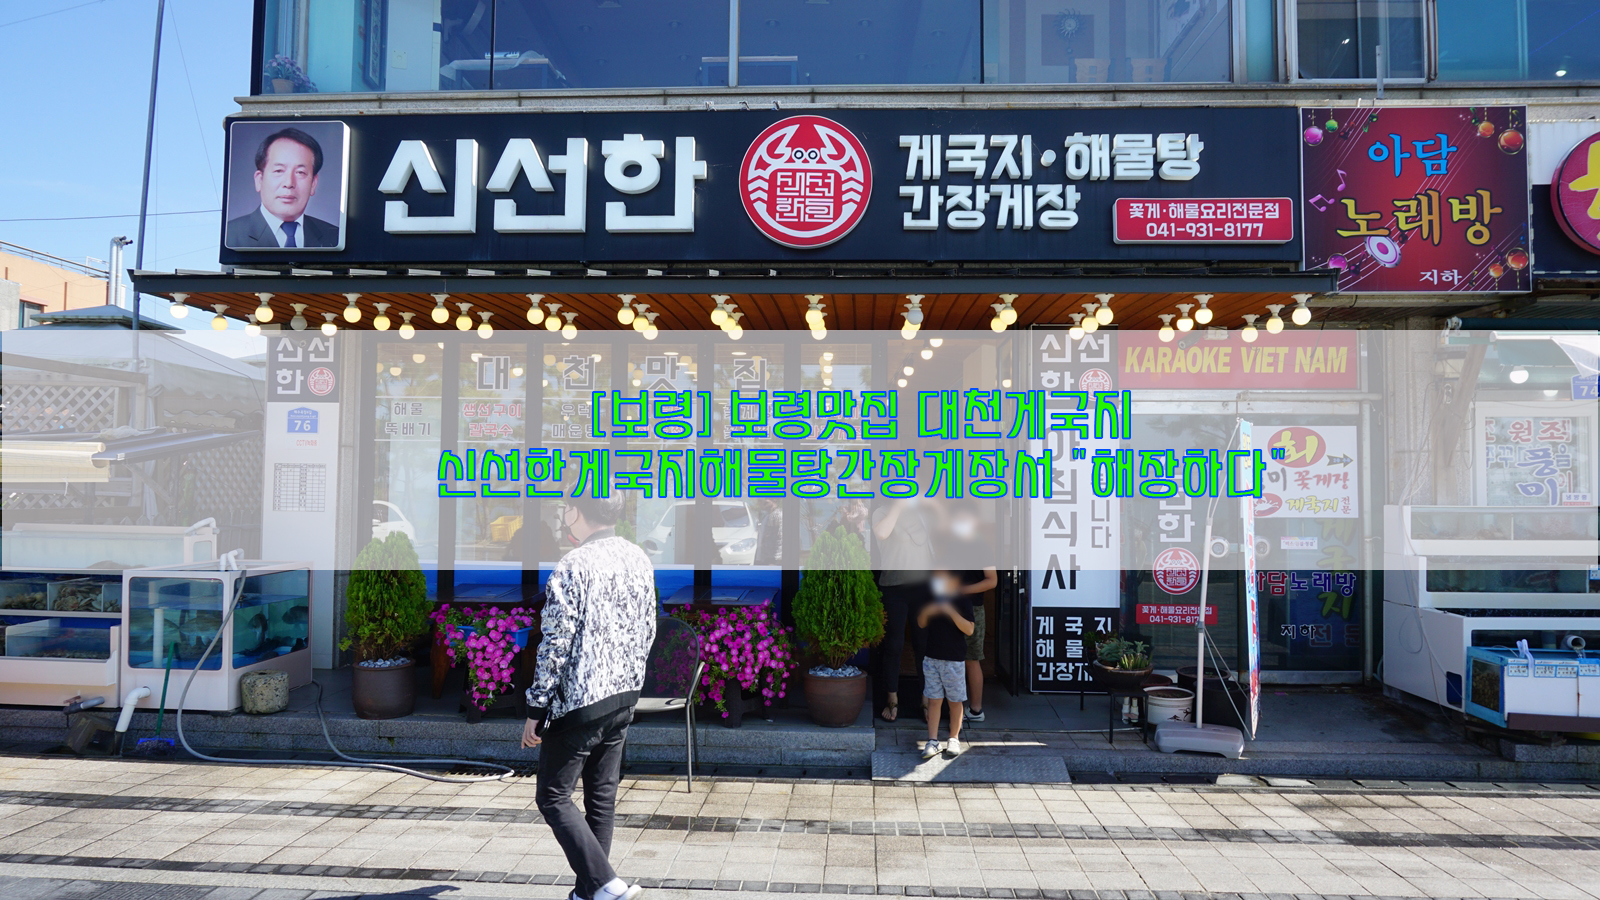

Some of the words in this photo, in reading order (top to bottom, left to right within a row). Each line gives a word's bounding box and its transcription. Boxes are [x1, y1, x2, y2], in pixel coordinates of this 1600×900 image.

[1368, 133, 1458, 177] 아담
[378, 133, 707, 234] 신선한
[900, 184, 1081, 230] 간장게장
[1336, 188, 1503, 246] 노래방
[1146, 223, 1264, 238] 041-931-8177
[1420, 269, 1462, 285] 지하
[276, 337, 335, 363] 신선
[1040, 333, 1110, 363] 신선
[1124, 346, 1232, 374] KARAOKE
[1240, 346, 1290, 374] VIET
[1294, 346, 1348, 374] NAM
[276, 368, 305, 395] 한
[1580, 385, 1600, 397] 74
[394, 402, 424, 416] 해물
[463, 403, 522, 417] 생선구이
[294, 420, 311, 431] 76
[384, 422, 432, 436] 뚝배기
[468, 423, 513, 437] 칼국수
[1273, 430, 1319, 464] 회
[1293, 470, 1349, 490] 꽃게장
[1285, 495, 1339, 514] 게국지
[1142, 605, 1212, 615] 꽃게·해물요리전점
[1149, 615, 1200, 623] 041-931-817
[1035, 616, 1112, 635] 게국지
[1281, 624, 1316, 639] 지하
[1035, 638, 1084, 658] 해물
[1036, 662, 1093, 681] 간장게
